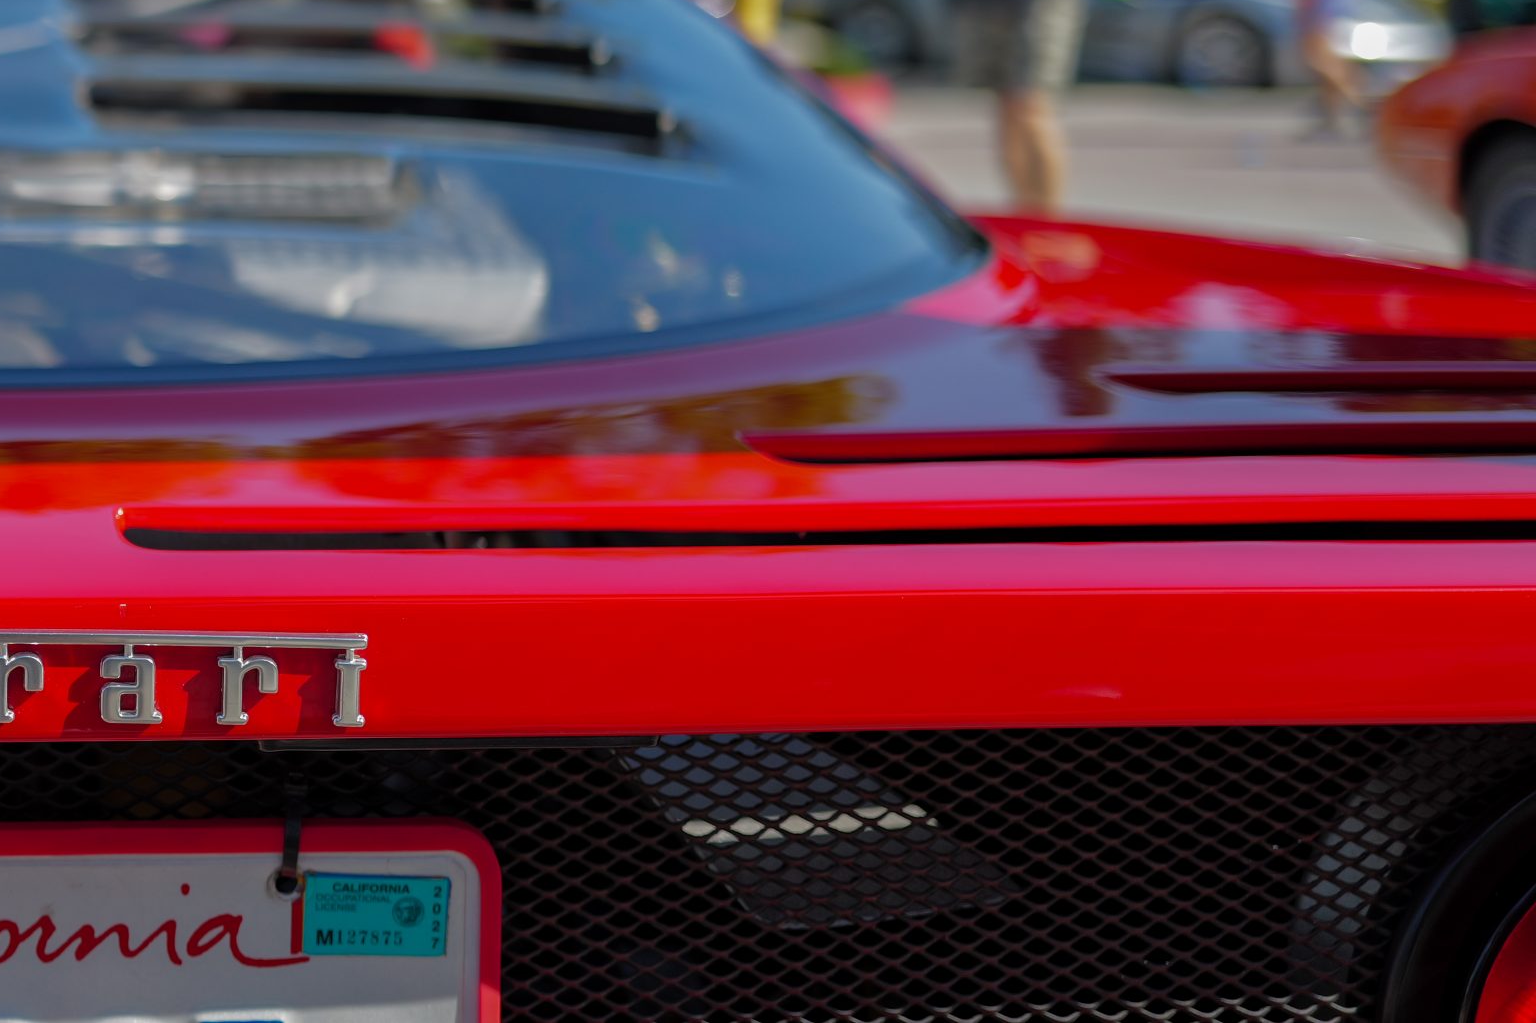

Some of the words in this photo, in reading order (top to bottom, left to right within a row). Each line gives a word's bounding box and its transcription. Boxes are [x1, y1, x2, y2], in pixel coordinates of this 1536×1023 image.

[332, 883, 410, 893] CALIFORNIA
[315, 893, 390, 903] OCCUPATIONAL
[315, 903, 357, 912] LICENSE
